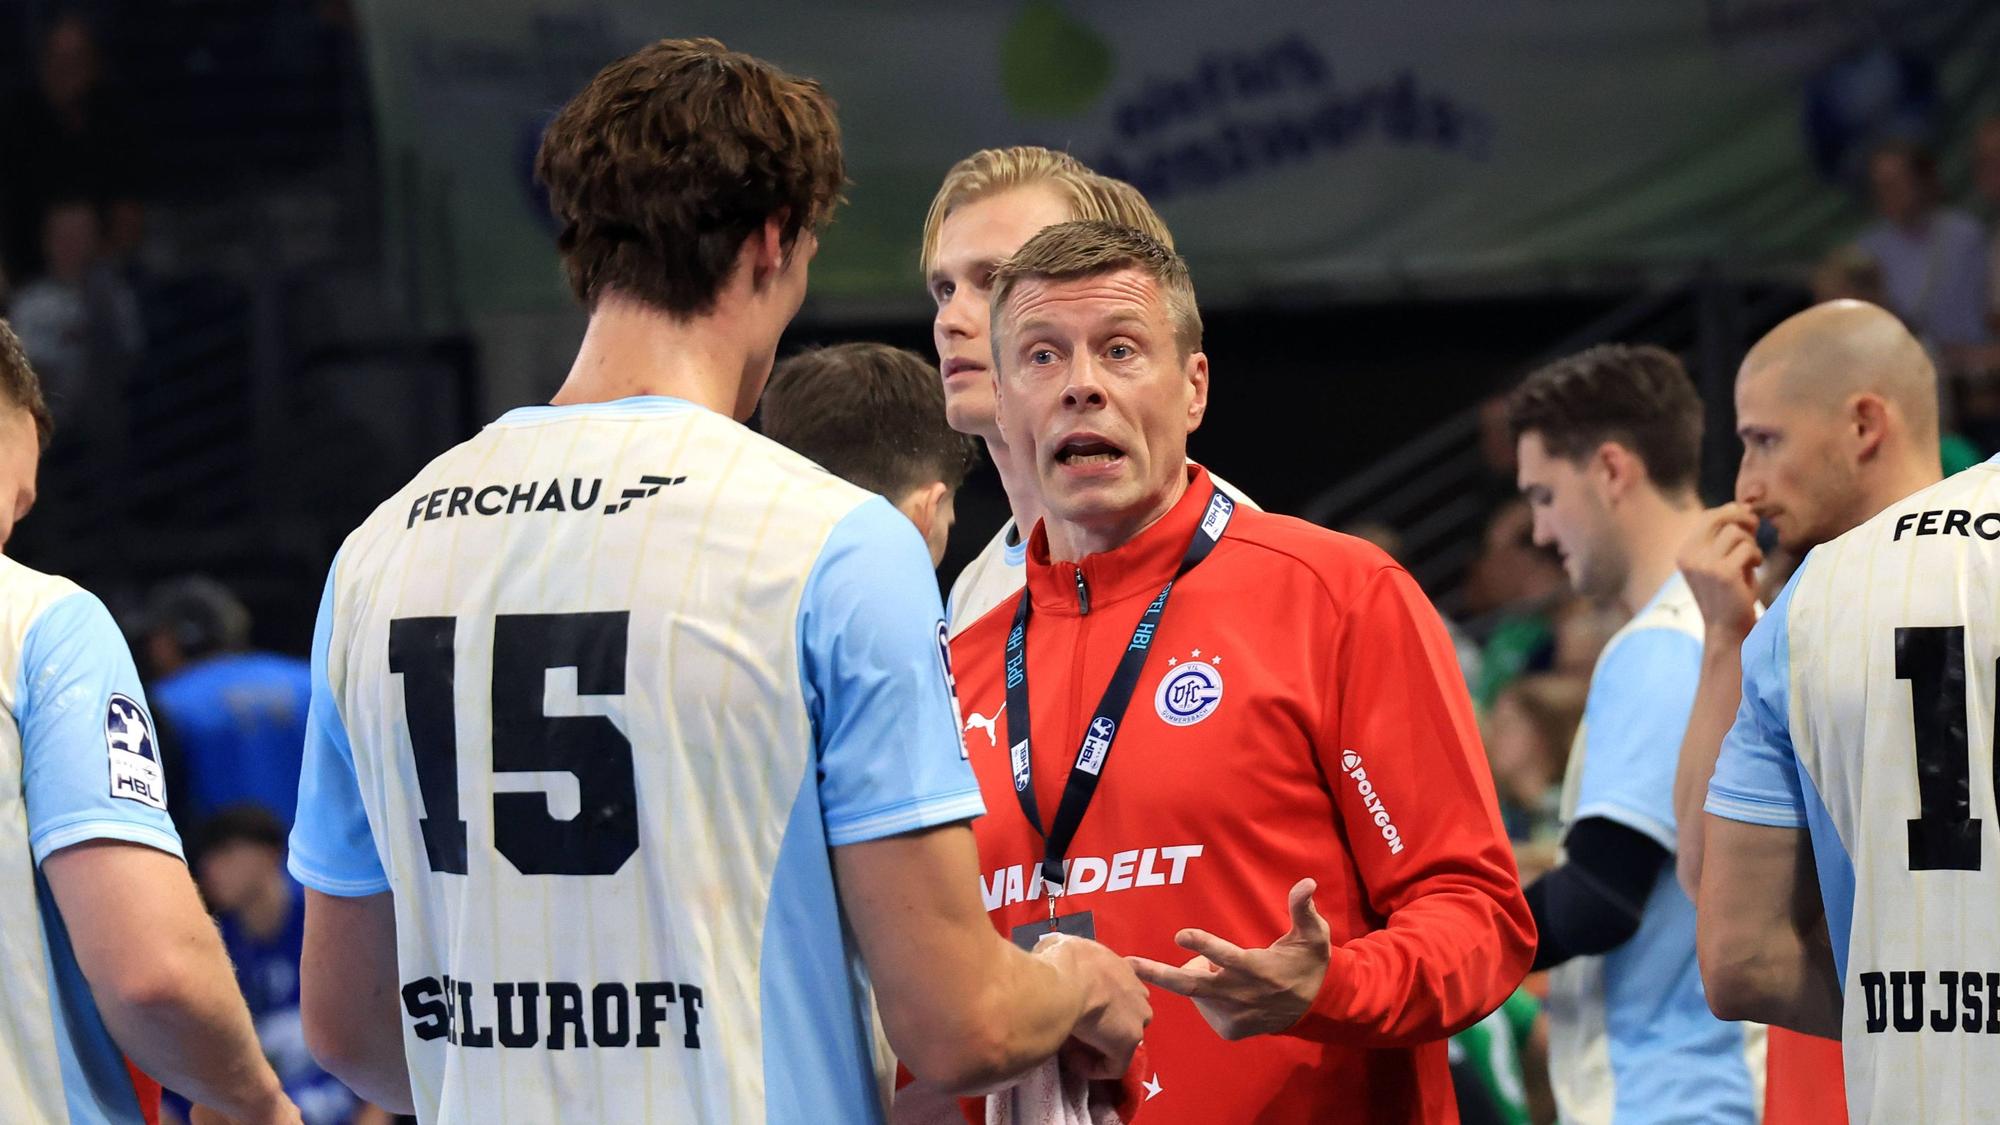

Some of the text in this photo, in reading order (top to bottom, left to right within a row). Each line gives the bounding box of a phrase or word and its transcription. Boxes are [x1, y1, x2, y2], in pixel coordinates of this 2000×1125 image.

[406, 478, 602, 529] FERCHAU
[1204, 507, 1220, 527] HBL
[1129, 623, 1155, 651] HBL
[1007, 649, 1024, 689] OPEL
[388, 610, 639, 875] 15
[1079, 739, 1097, 766] HBL
[1895, 625, 2000, 871] 1
[117, 773, 160, 802] HBL
[1350, 767, 1404, 855] POLYGON
[402, 975, 704, 1049] SHLUROFF
